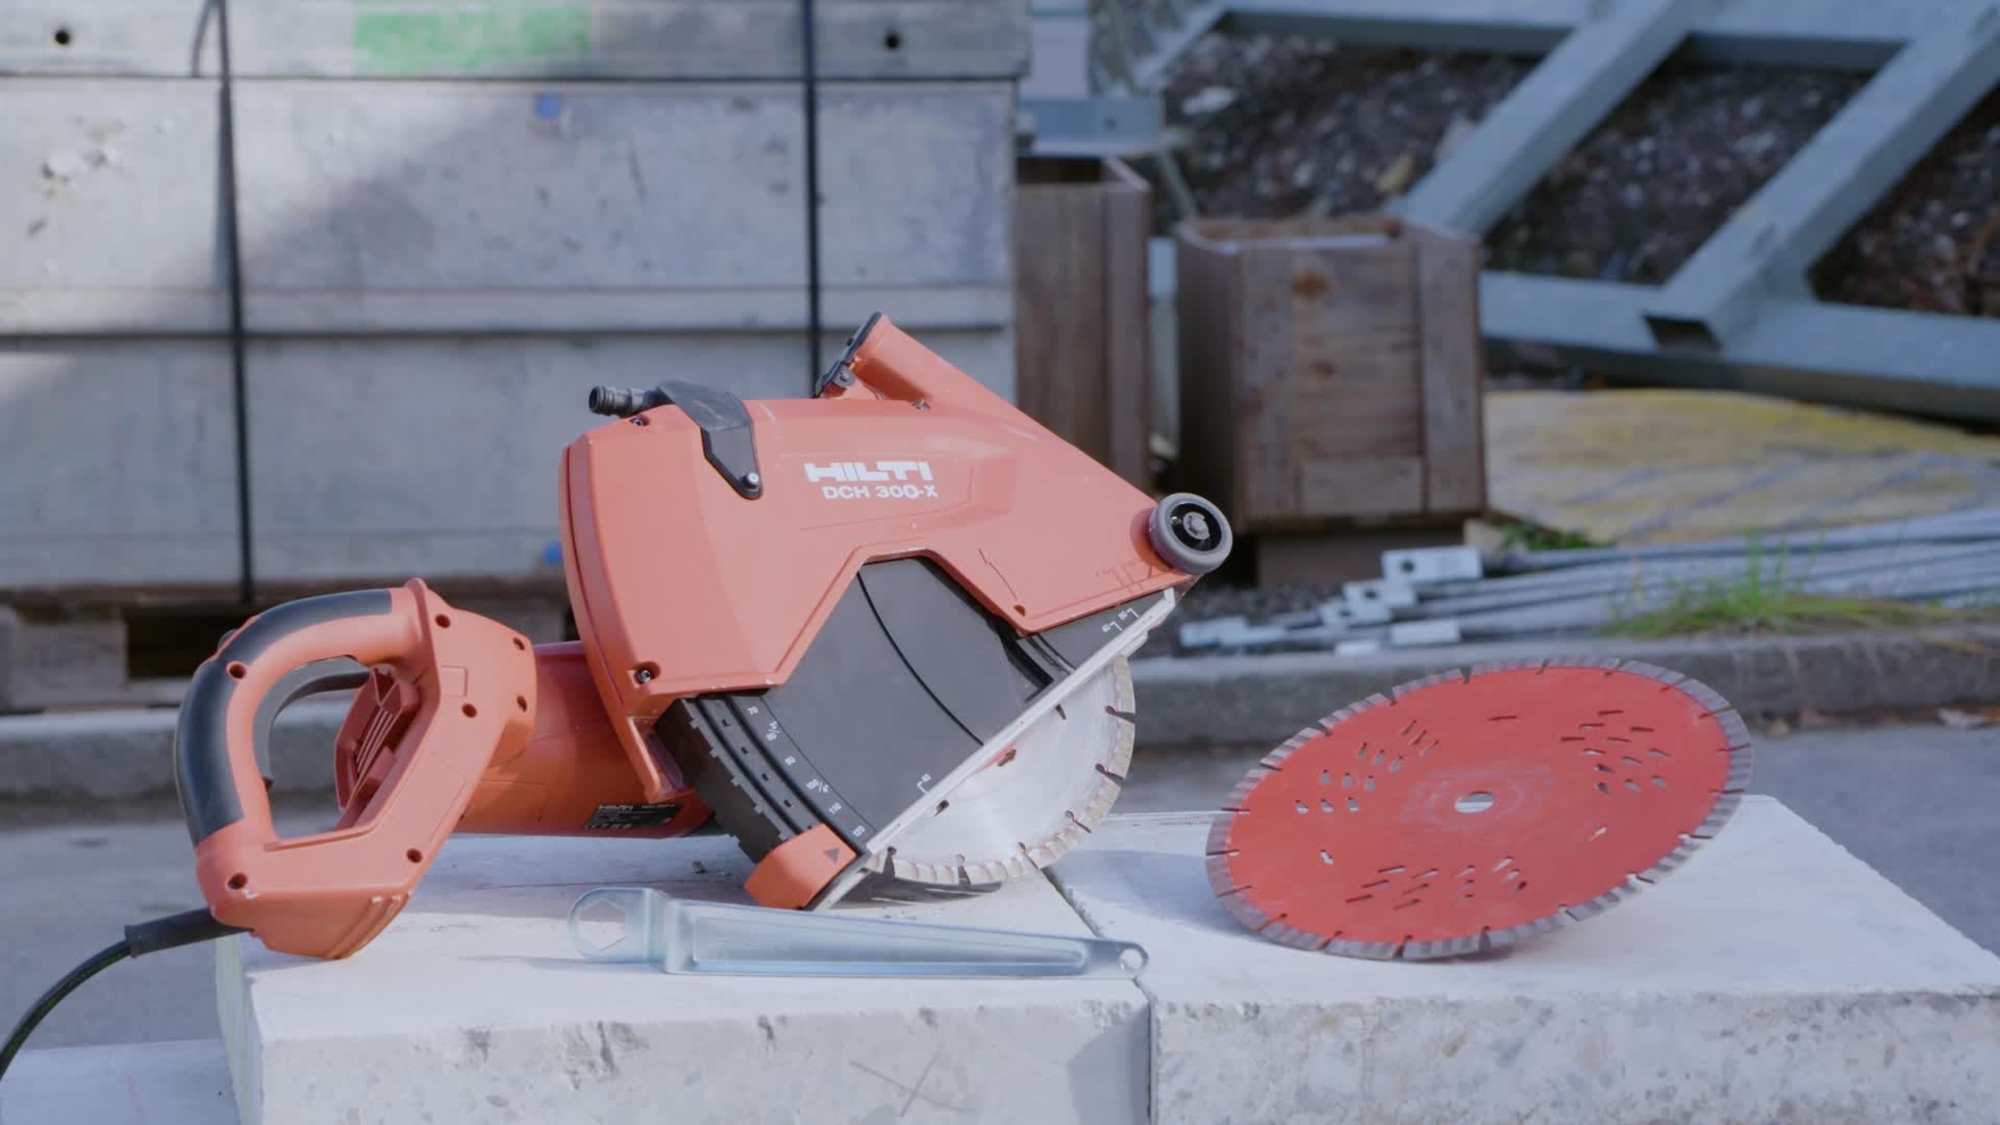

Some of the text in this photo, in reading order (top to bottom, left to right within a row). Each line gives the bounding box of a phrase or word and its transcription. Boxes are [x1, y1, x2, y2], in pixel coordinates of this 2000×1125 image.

[803, 461, 934, 482] HILTI
[821, 484, 939, 499] DCH 300-X
